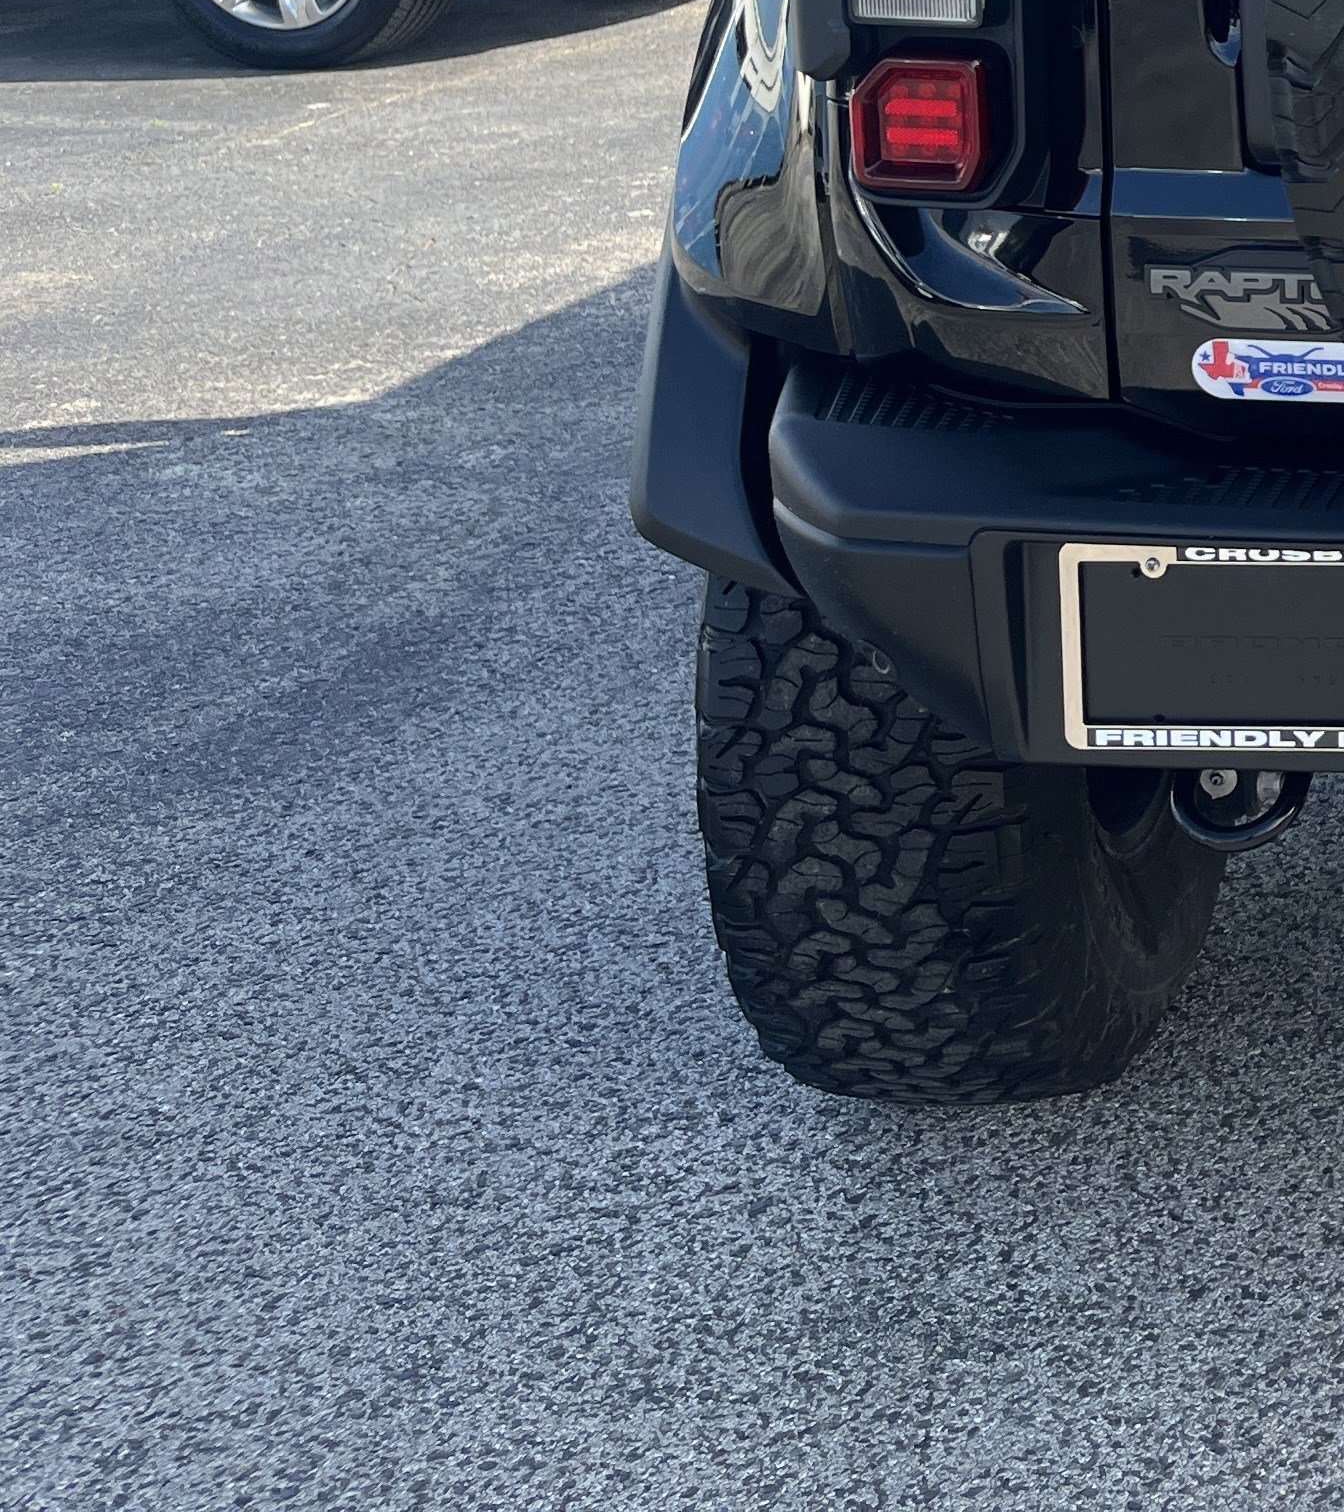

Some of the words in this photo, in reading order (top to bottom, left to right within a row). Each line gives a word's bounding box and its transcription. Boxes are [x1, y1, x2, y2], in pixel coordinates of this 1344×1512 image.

[1150, 268, 1324, 306] RAPT
[1270, 379, 1303, 394] Ford
[1095, 729, 1325, 748] FRIENDLY
